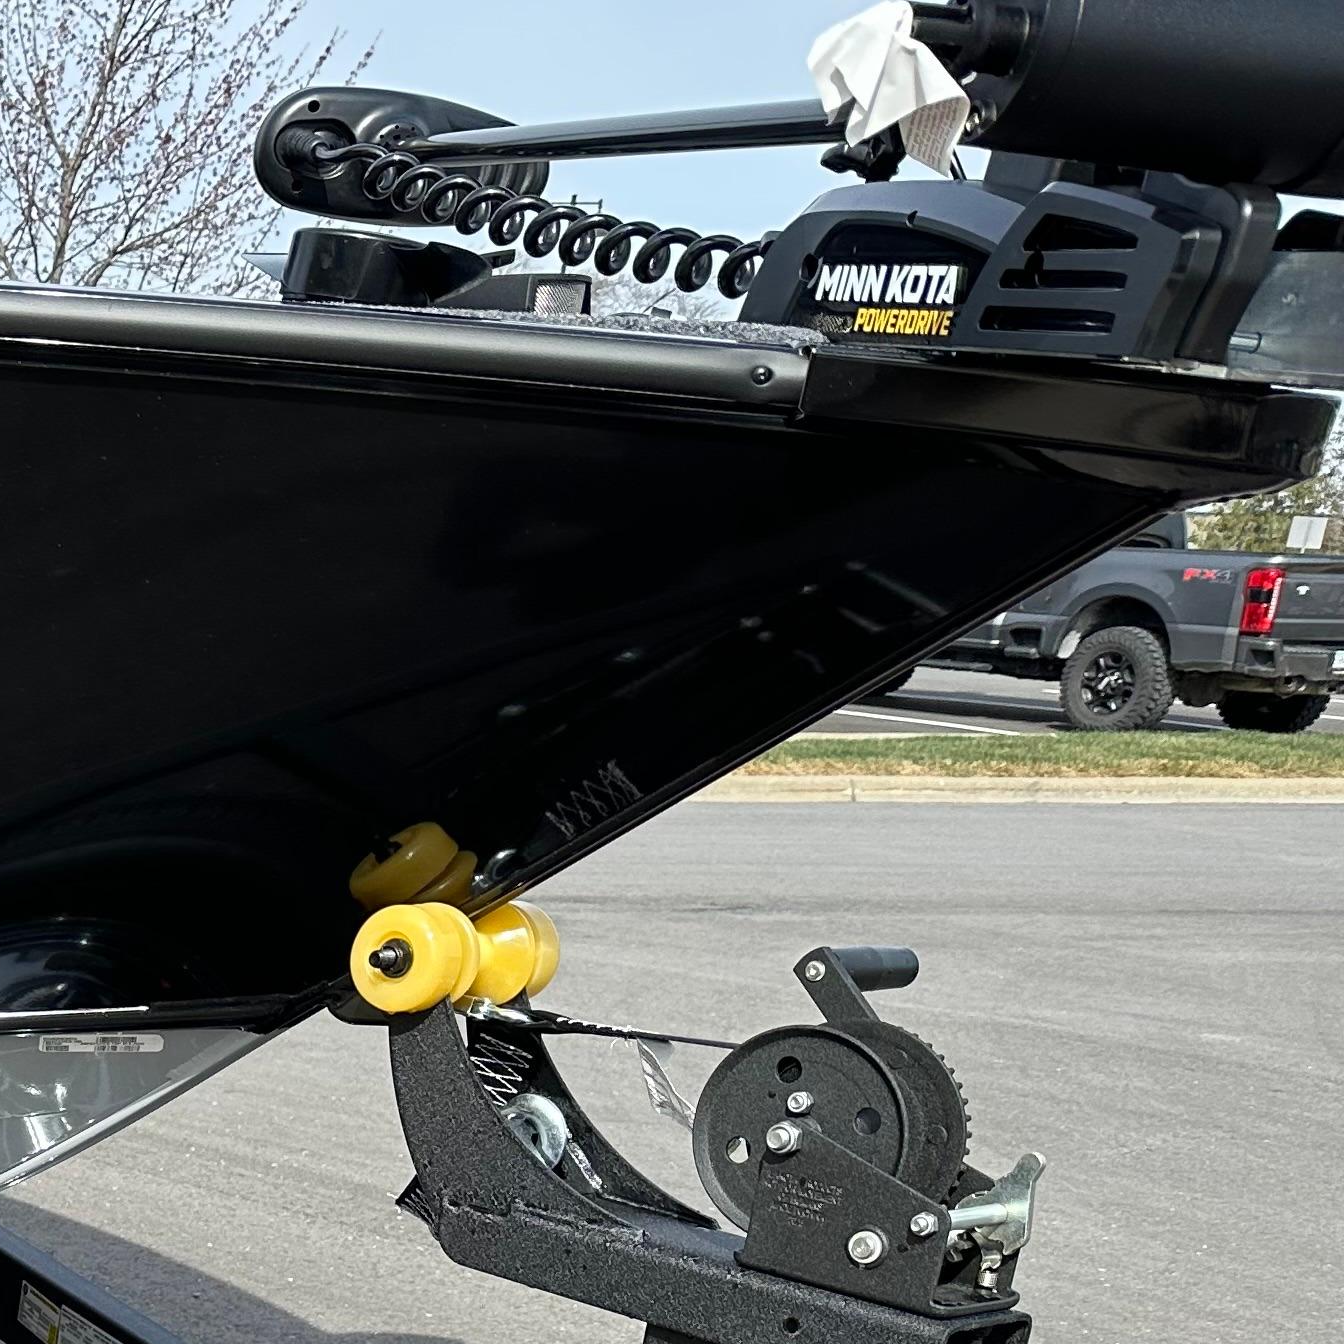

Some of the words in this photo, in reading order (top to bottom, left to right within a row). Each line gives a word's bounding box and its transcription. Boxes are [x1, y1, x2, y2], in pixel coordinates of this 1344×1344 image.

[815, 264, 888, 303] MINN
[884, 264, 959, 305] KOTA
[853, 307, 954, 336] POWERDRIVE
[1182, 567, 1232, 582] FX4
